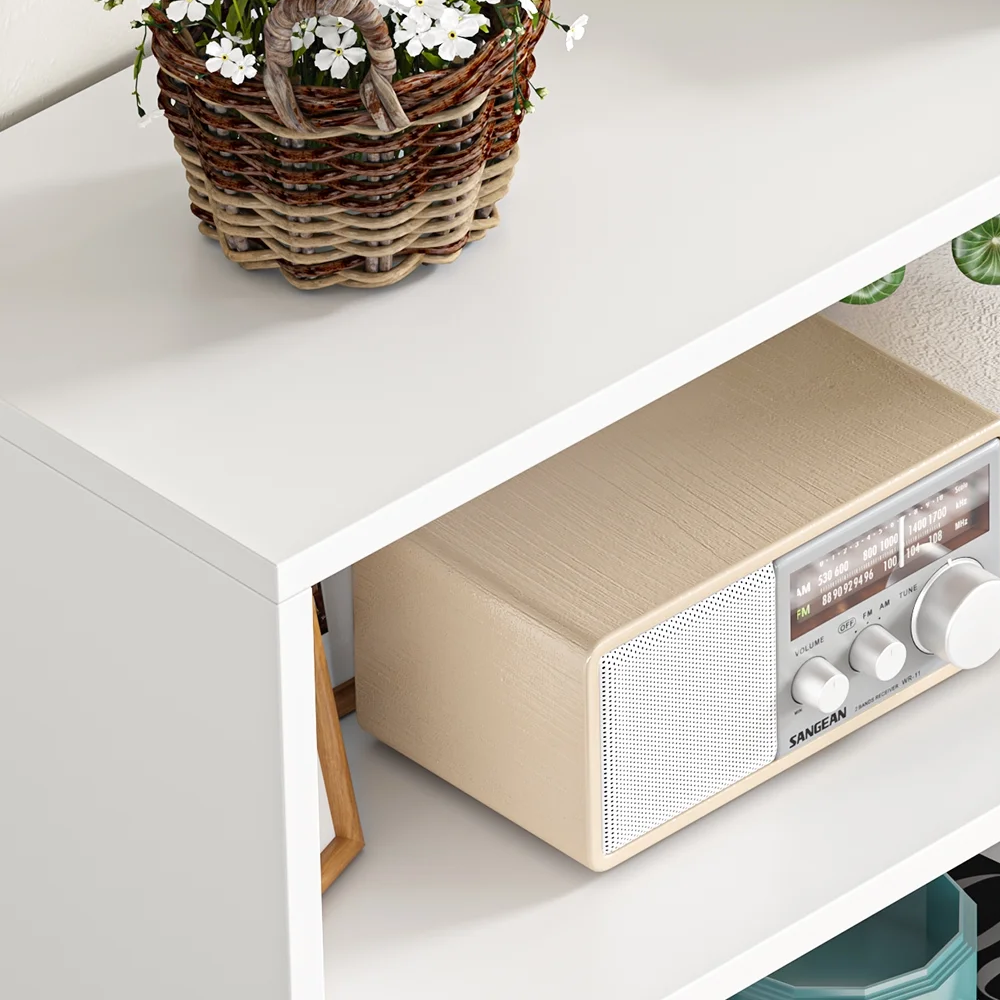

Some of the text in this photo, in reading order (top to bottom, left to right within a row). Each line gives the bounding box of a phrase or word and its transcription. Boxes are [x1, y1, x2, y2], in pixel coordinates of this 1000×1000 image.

[796, 582, 811, 598] AM
[818, 570, 833, 587] 530
[834, 561, 849, 578] 600
[862, 545, 878, 562] 800
[880, 533, 899, 552] 1000
[908, 517, 927, 536] 1400
[928, 506, 947, 524] 1700
[796, 517, 968, 621] FM 88 90 92 94 96 100 104 108 MHz
[899, 584, 918, 600] TUNE
[839, 599, 890, 633] OFF FM AM
[794, 636, 825, 657] VOLUME
[901, 670, 921, 685] WR-11
[875, 683, 899, 700] RECEIVER
[789, 706, 847, 749] SANGEAN
